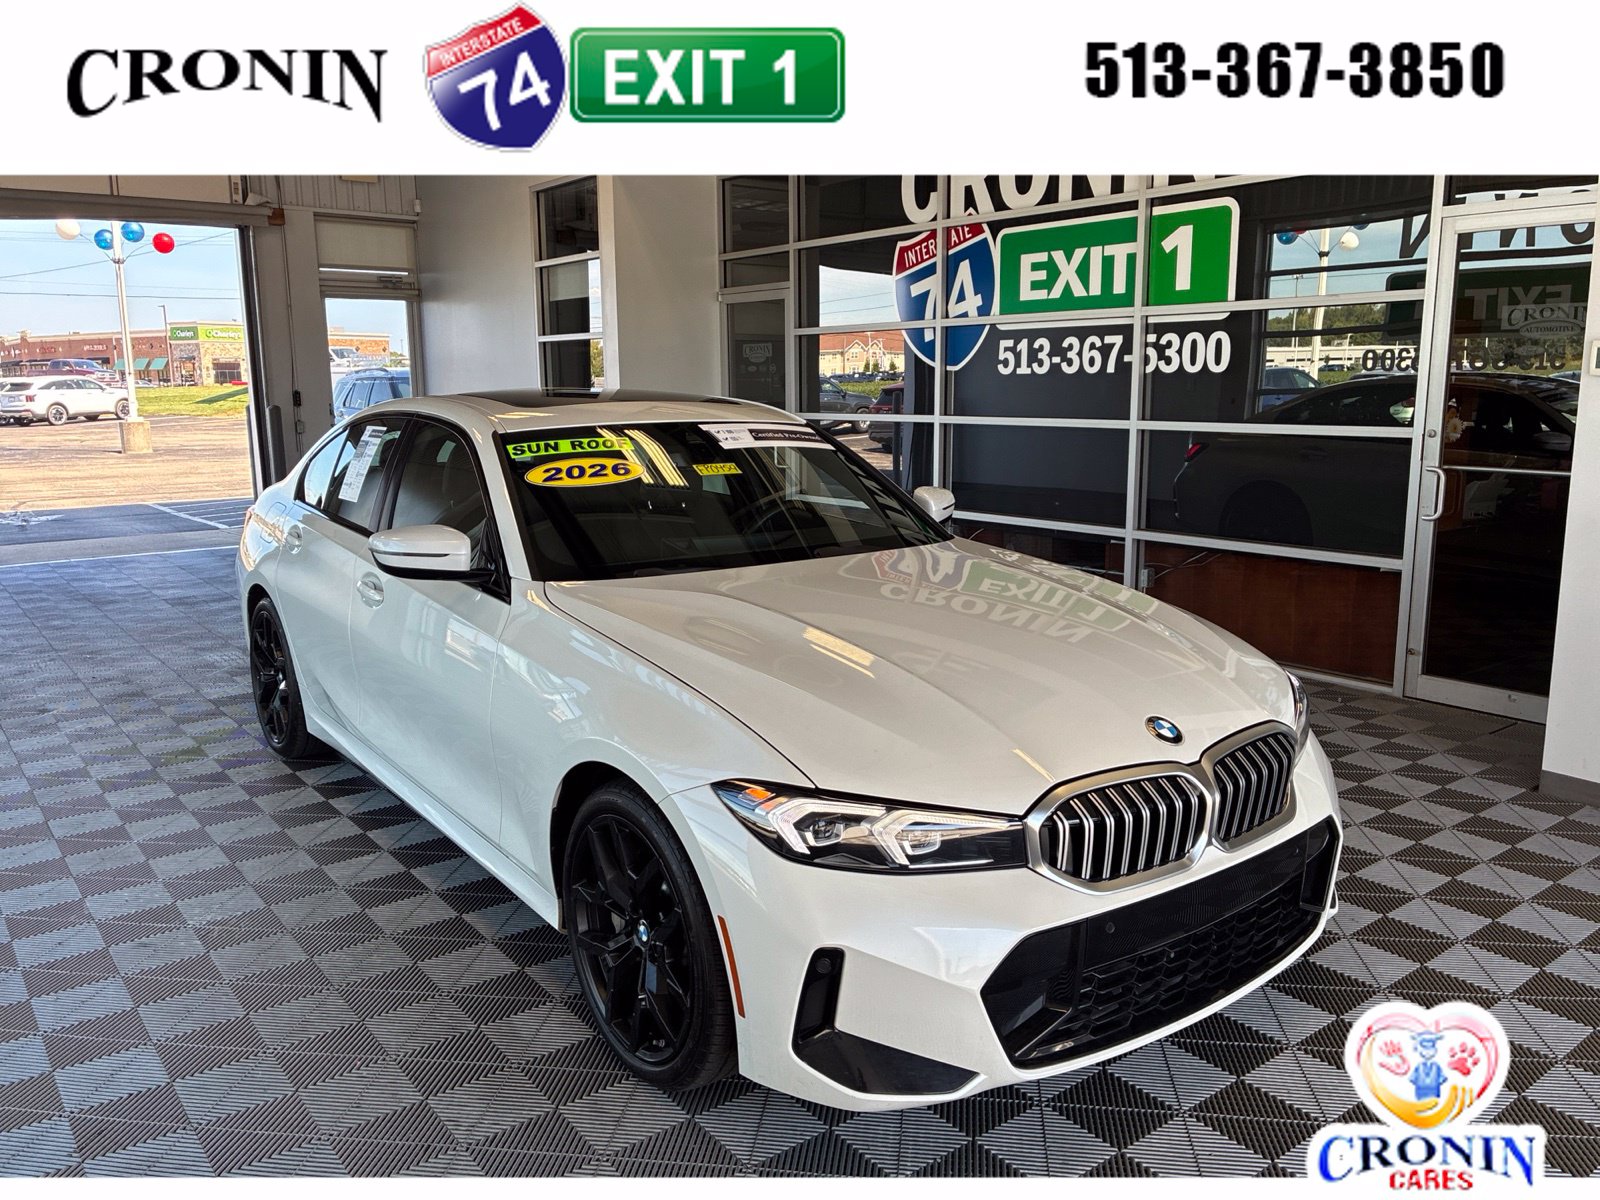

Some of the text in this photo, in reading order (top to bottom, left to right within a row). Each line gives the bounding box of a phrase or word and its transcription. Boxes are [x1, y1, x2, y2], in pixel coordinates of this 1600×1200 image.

[902, 174, 1217, 224] CRO
[904, 225, 972, 268] INTERATE
[1019, 224, 1194, 301] EXIT 1
[910, 259, 983, 342] 74
[1523, 324, 1576, 334] AUTOMOTIVE
[997, 330, 1231, 375] 513-367-5300
[511, 438, 628, 456] SUN ROOF
[540, 462, 632, 483] 2026
